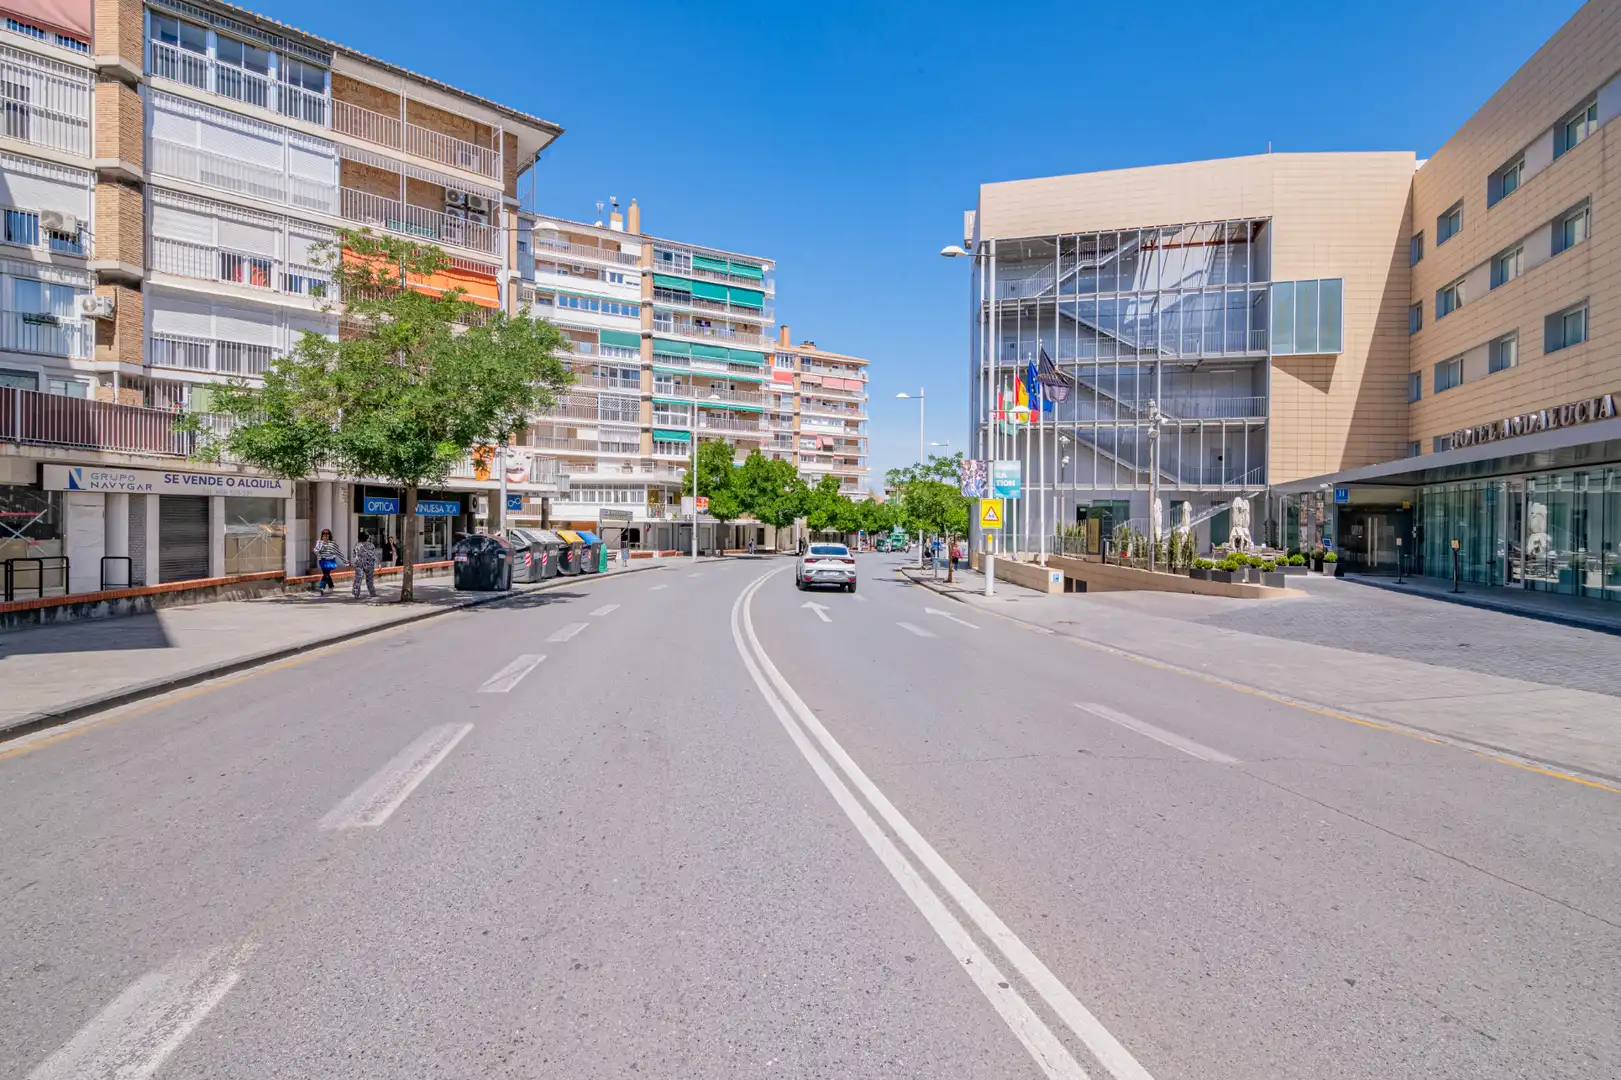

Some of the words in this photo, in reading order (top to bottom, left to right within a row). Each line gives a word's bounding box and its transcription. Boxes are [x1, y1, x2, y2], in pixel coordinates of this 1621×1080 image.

[1449, 423, 1497, 450] HOTEL
[1500, 394, 1616, 440] ANDALUCIA
[90, 472, 135, 482] GRUPO
[164, 473, 180, 484] SE
[182, 475, 223, 486] VENDE
[226, 477, 235, 487] O
[237, 478, 282, 489] ALQUILA
[90, 481, 153, 491] NAVYGAR
[367, 501, 395, 512] OPTICA
